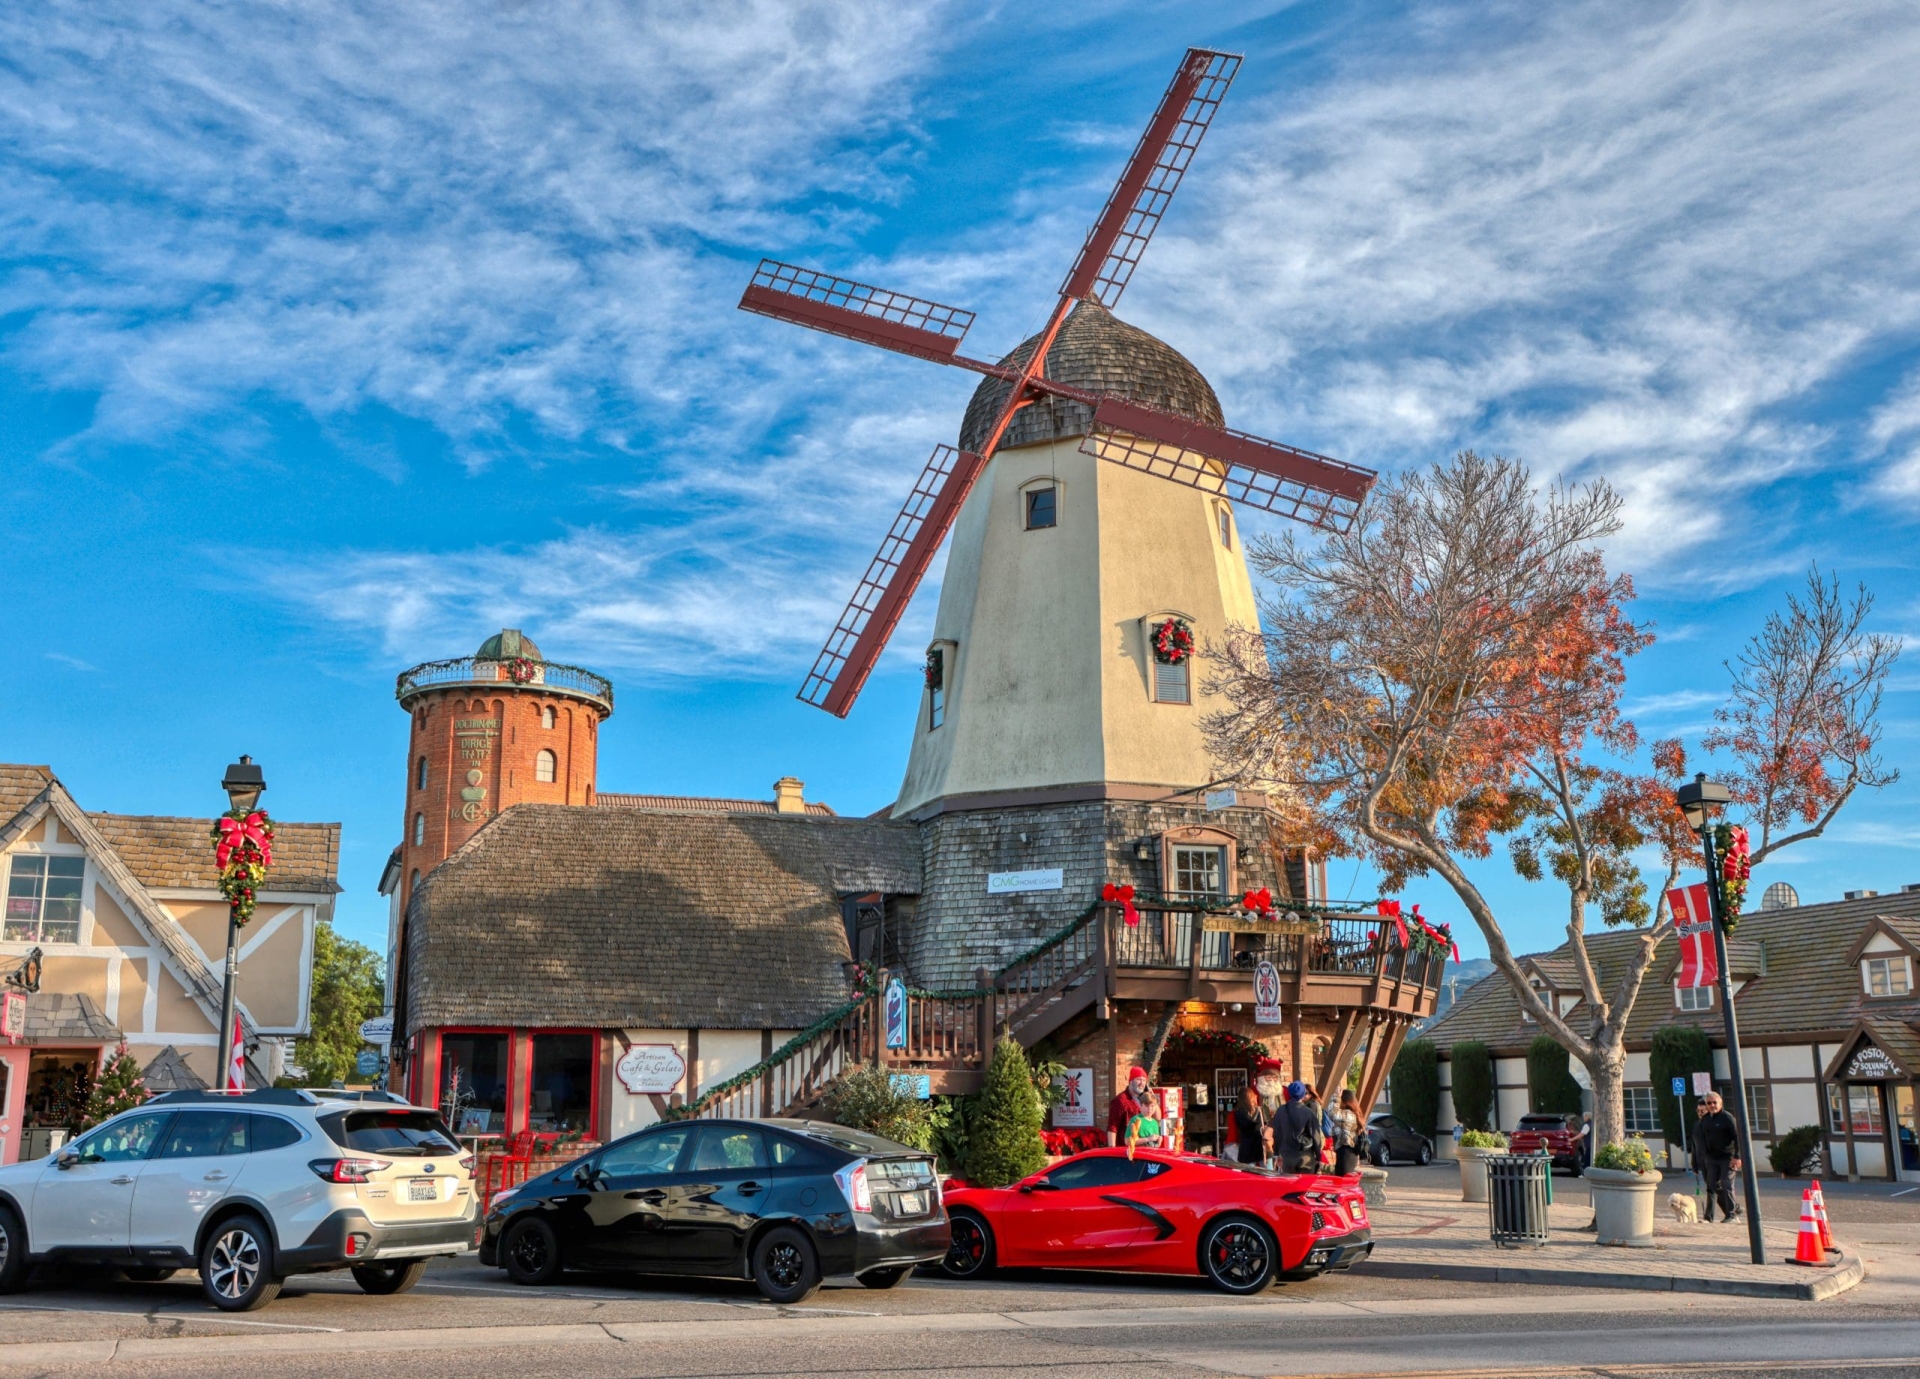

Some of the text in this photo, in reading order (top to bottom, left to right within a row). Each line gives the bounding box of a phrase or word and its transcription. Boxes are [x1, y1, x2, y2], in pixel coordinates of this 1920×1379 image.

[461, 738, 492, 749] DIRIGE
[992, 876, 1059, 888] CMG HOME LOANS
[1216, 921, 1233, 930] THE
[1679, 920, 1711, 939] Solvang
[635, 1051, 666, 1060] Artisan
[621, 1061, 643, 1075] Café
[651, 1060, 682, 1075] Gelato
[1860, 1062, 1889, 1071] SOLVANG
